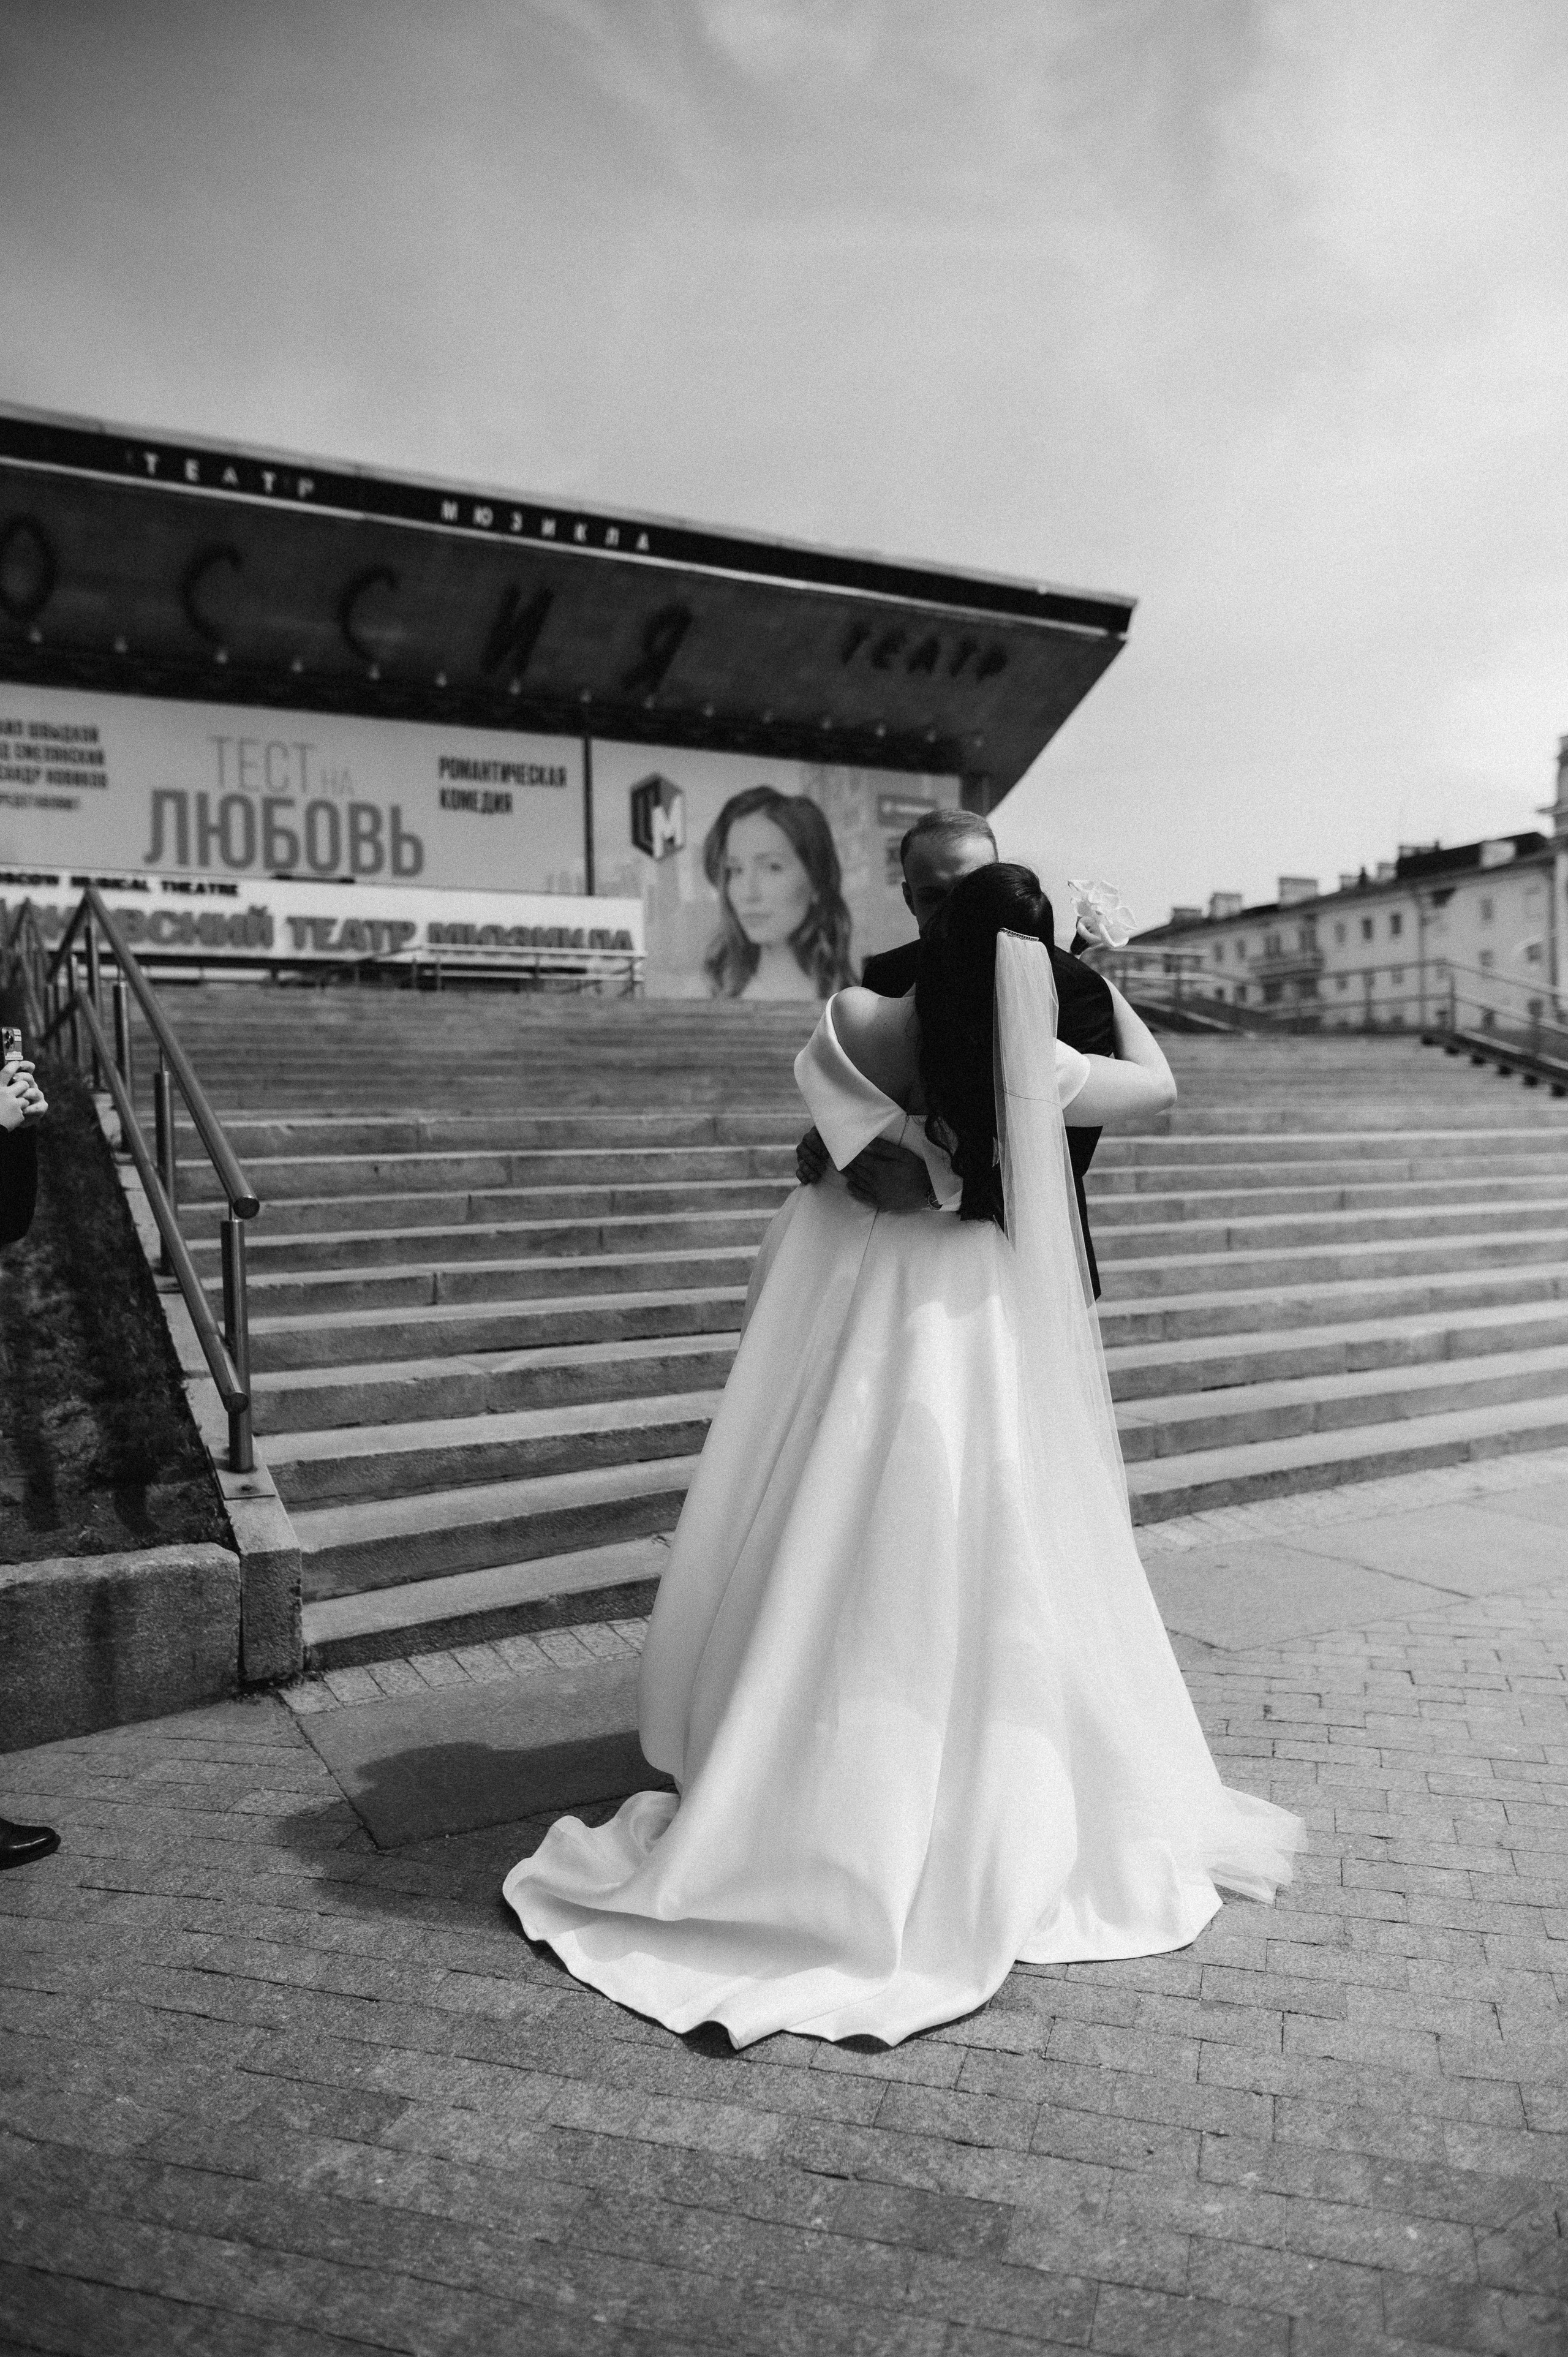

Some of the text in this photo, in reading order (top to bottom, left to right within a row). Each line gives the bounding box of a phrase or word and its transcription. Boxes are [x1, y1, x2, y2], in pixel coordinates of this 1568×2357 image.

[144, 451, 649, 551] ТЕАТР МЮЗИКЛА
[208, 735, 355, 798] ТЕСТ НА
[439, 755, 567, 788] РОМАНТИЧЕСКАЯ
[439, 788, 513, 815] КОМЕДИЯ
[144, 788, 425, 878] ЛЮБОВЬ
[161, 880, 238, 897] THEATRE
[285, 916, 418, 952] ТЕАТР
